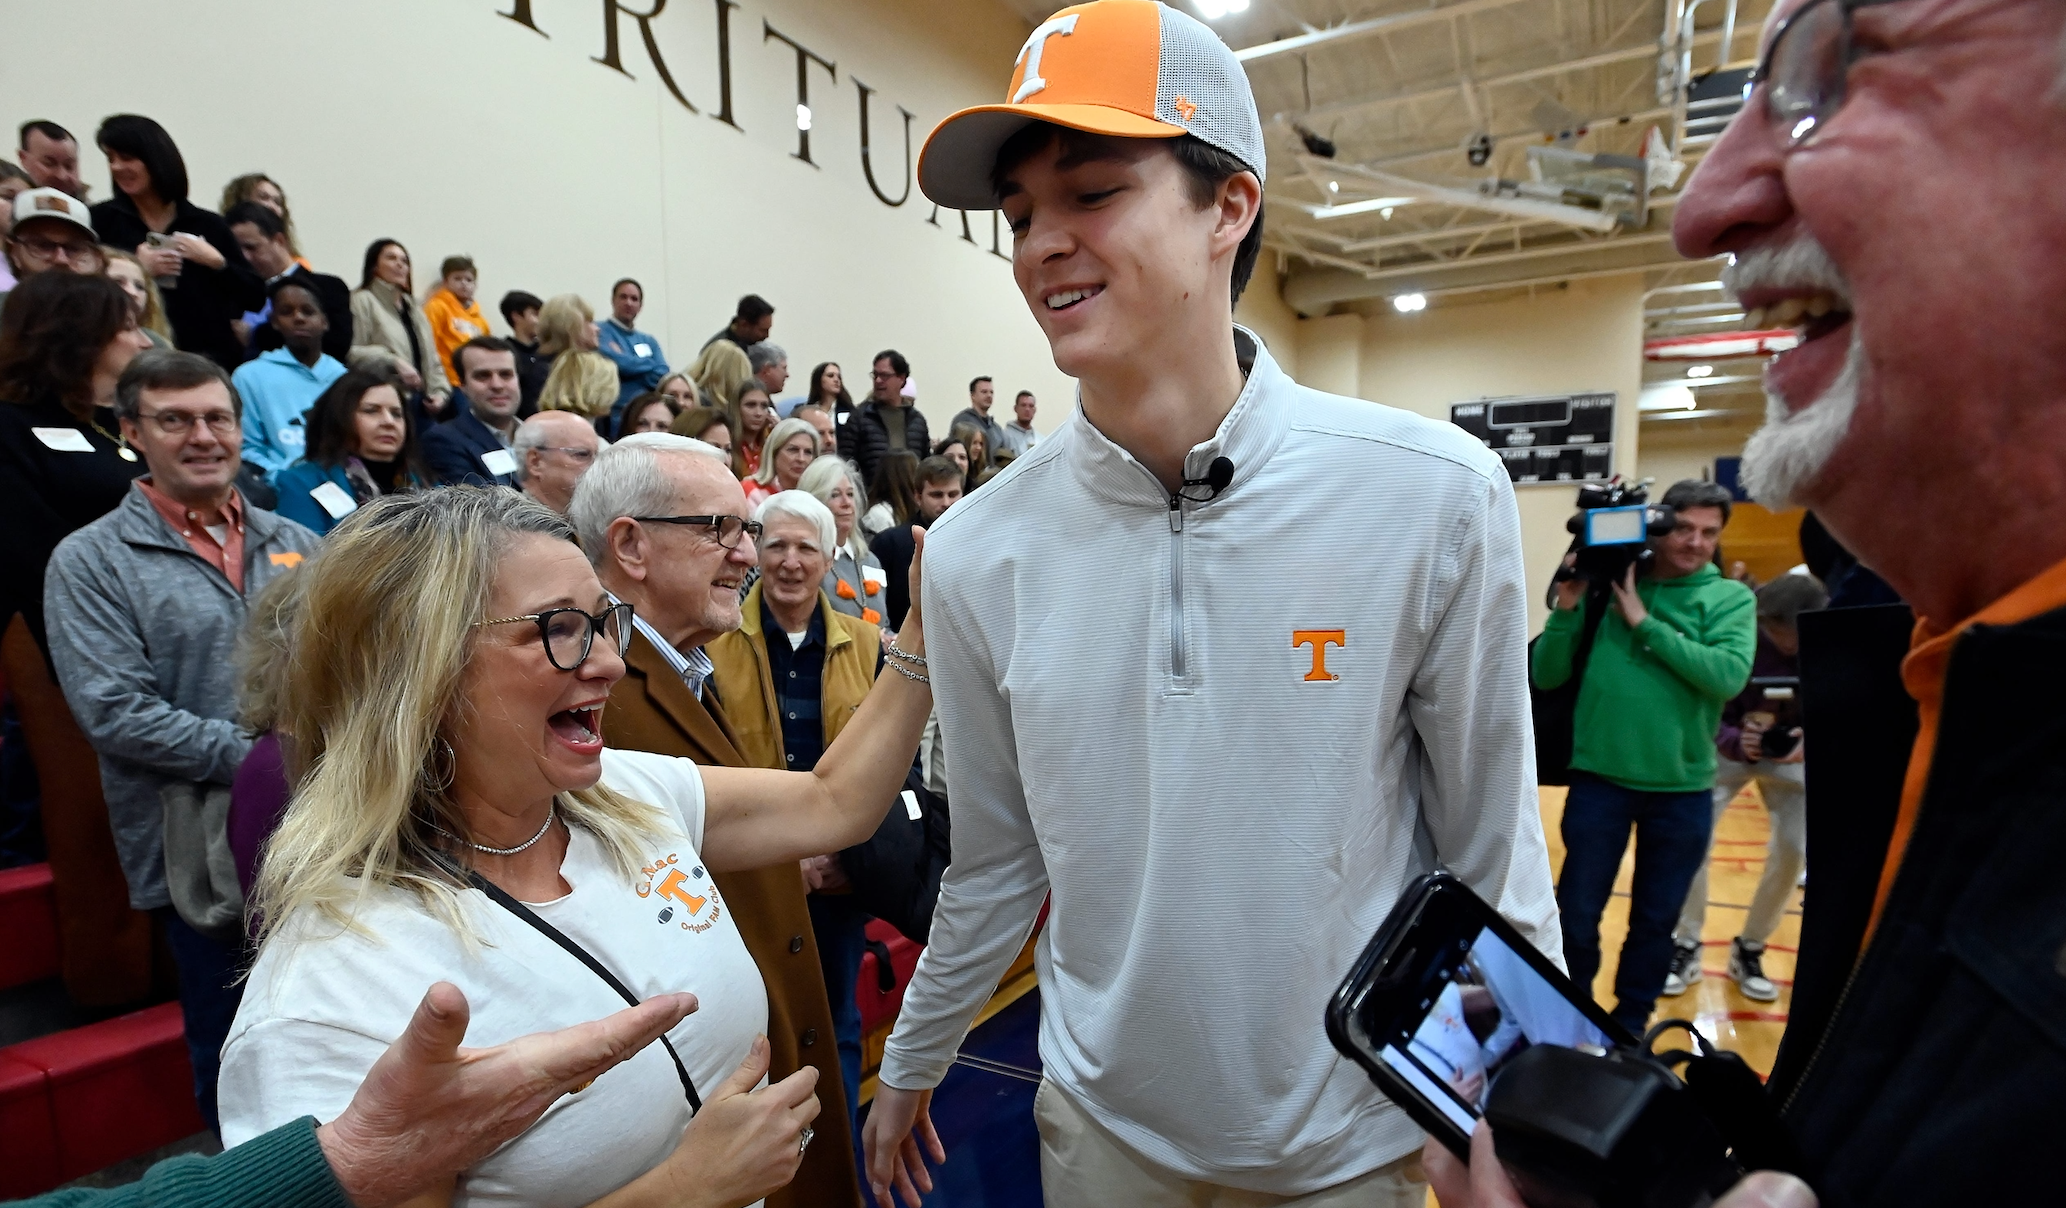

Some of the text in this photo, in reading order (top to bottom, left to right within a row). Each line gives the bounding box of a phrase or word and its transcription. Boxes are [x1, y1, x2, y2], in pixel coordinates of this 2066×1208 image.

[1012, 13, 1080, 104] T
[1293, 629, 1345, 682] T
[654, 867, 707, 917] T
[708, 885, 719, 904] Club
